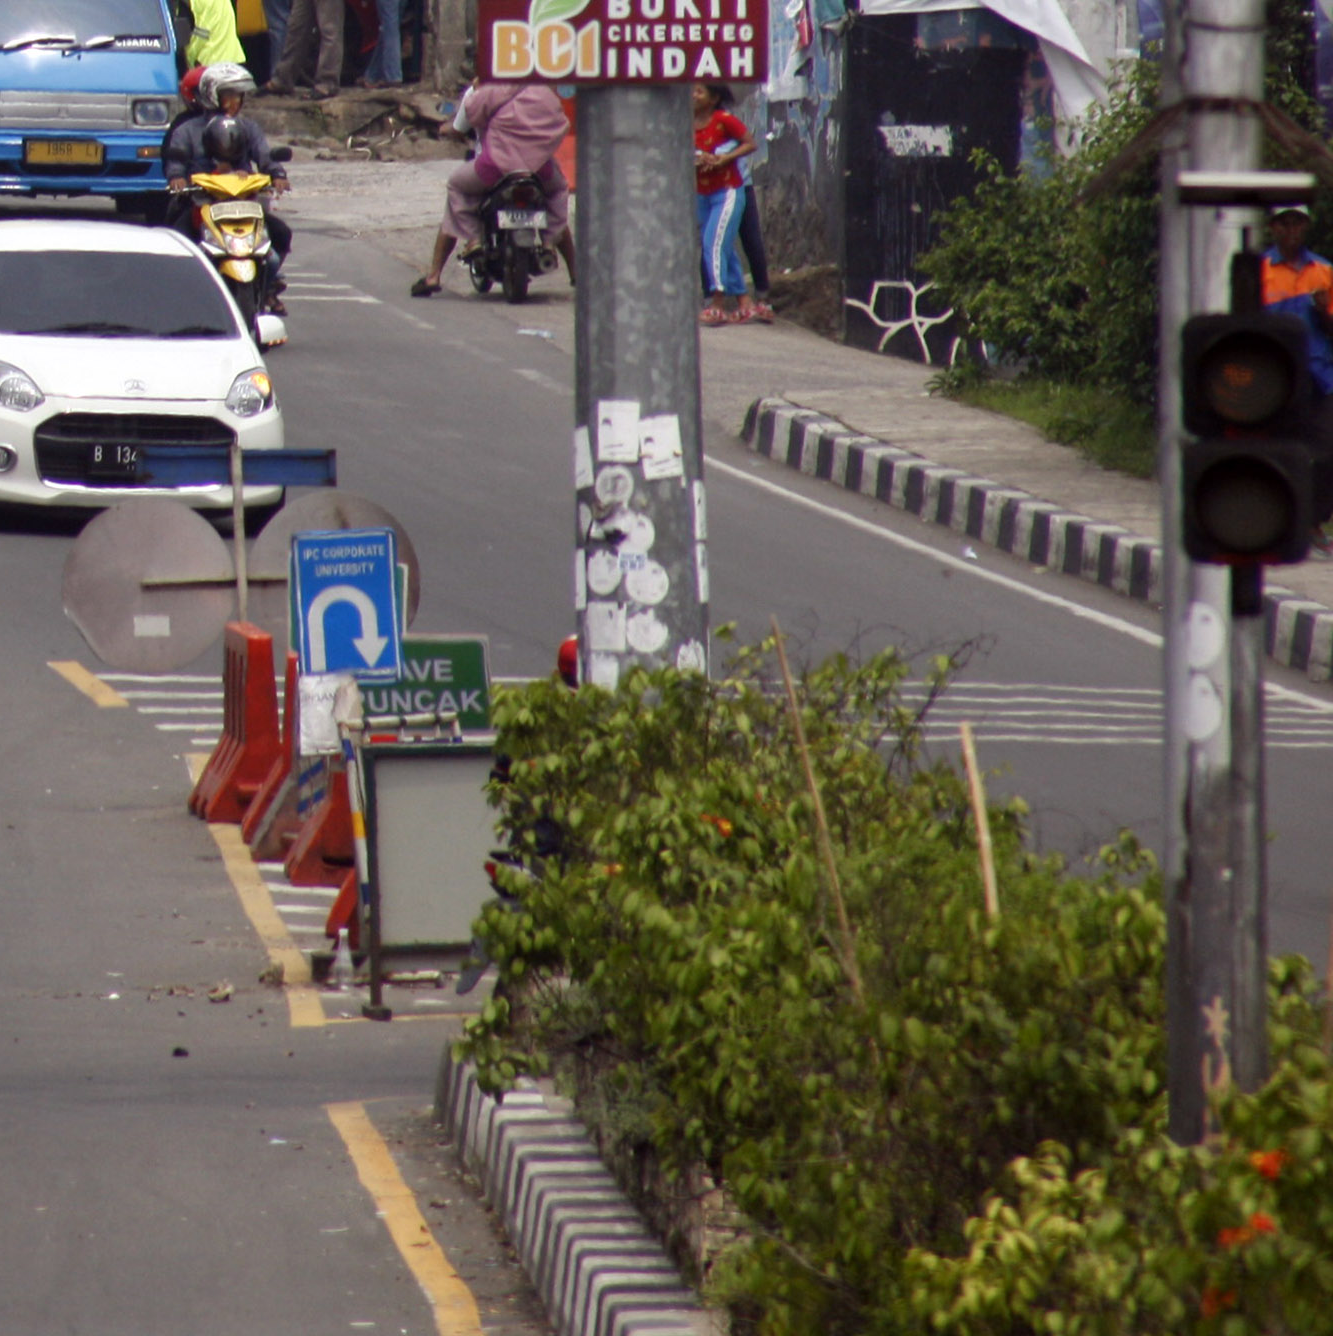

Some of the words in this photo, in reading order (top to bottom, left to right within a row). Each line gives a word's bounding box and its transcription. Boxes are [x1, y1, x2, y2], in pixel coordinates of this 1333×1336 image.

[607, 24, 754, 42] CIKERETEG
[606, 47, 754, 78] INDAH
[95, 445, 103, 463] B
[303, 545, 320, 560] IPC
[322, 544, 386, 559] CORPORATE
[315, 562, 376, 578] UNIVERSITY
[402, 659, 453, 683] AVE
